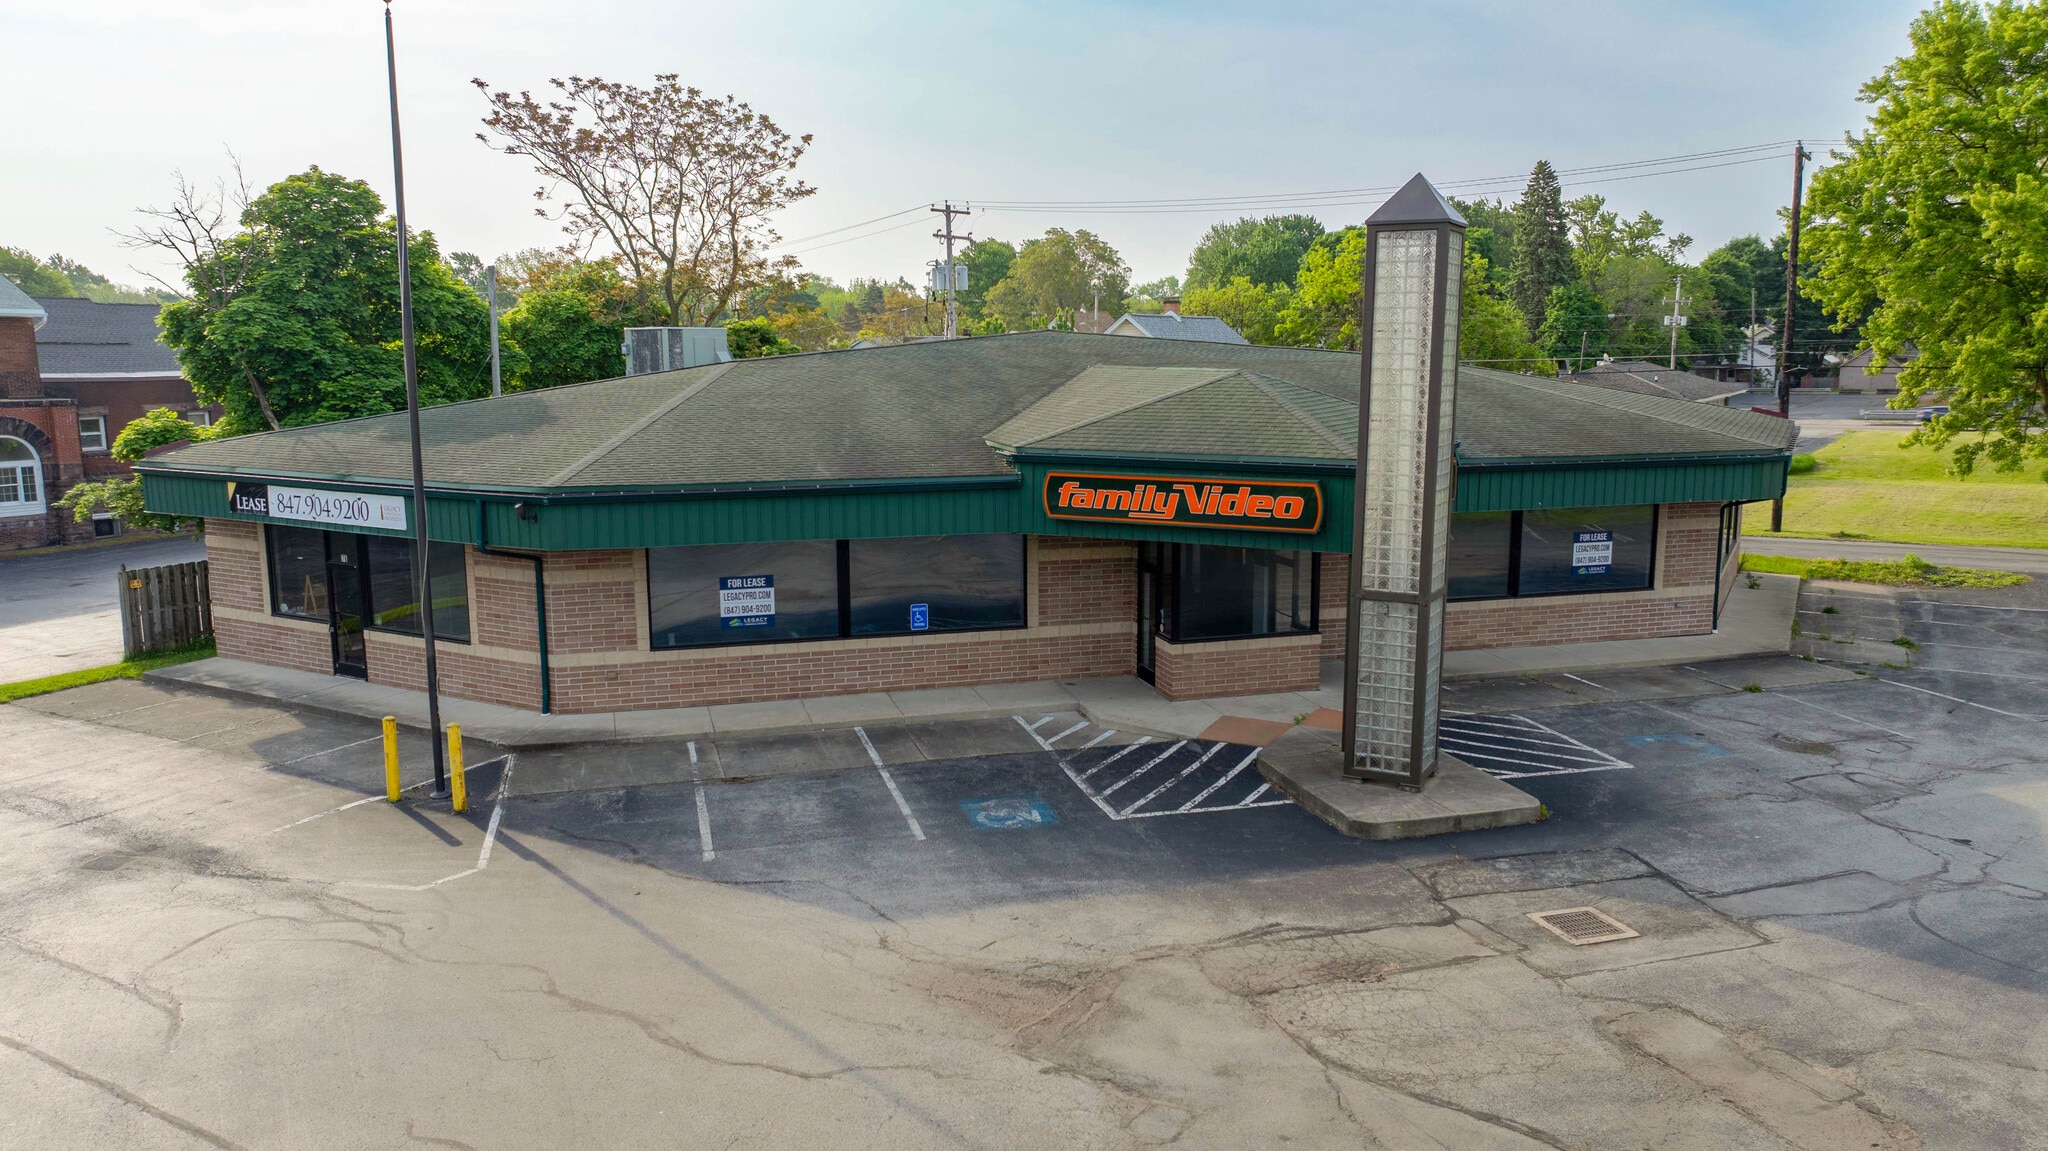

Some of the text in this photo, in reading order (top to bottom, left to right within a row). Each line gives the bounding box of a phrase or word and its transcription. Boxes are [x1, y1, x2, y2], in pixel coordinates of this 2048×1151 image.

[235, 494, 267, 512] LEASE
[277, 492, 370, 522] 847.904.9200
[1058, 482, 1304, 519] family Video
[1579, 532, 1608, 542] FOR LEASE
[727, 577, 766, 588] FOR LEASE
[723, 590, 772, 602] LEGACYPRO.COM
[723, 603, 772, 616] (847) 904-9200
